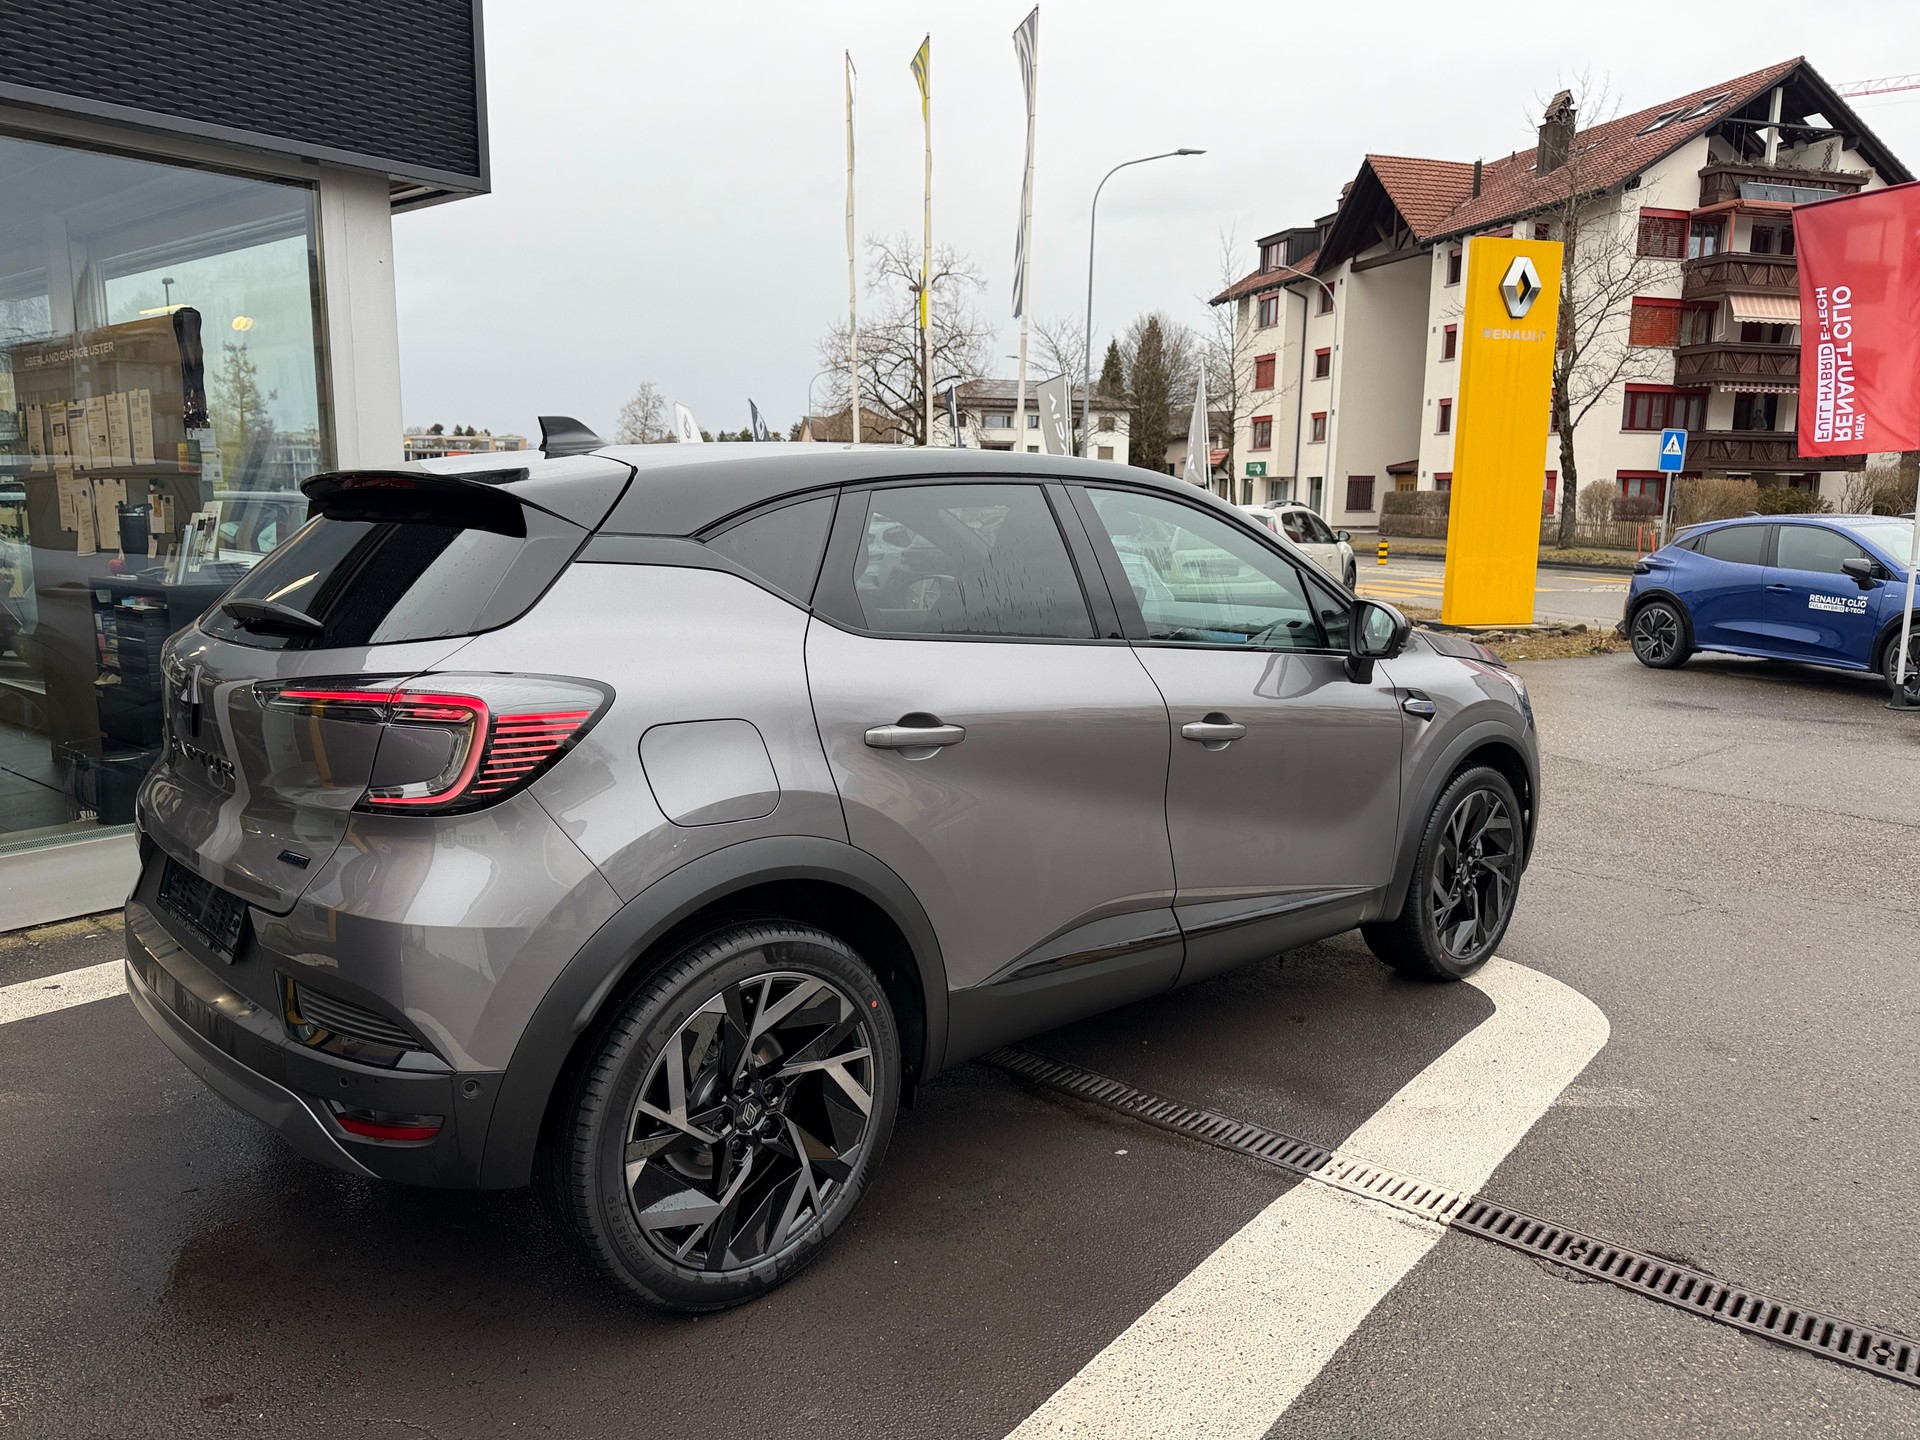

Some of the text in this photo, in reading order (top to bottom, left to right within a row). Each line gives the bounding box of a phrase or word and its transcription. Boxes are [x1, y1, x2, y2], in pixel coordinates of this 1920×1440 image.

[1482, 328, 1547, 341] RENAULT
[59, 346, 89, 360] GARAGE
[89, 341, 114, 355] USTER
[1809, 593, 1867, 608] RENAULT CLIO
